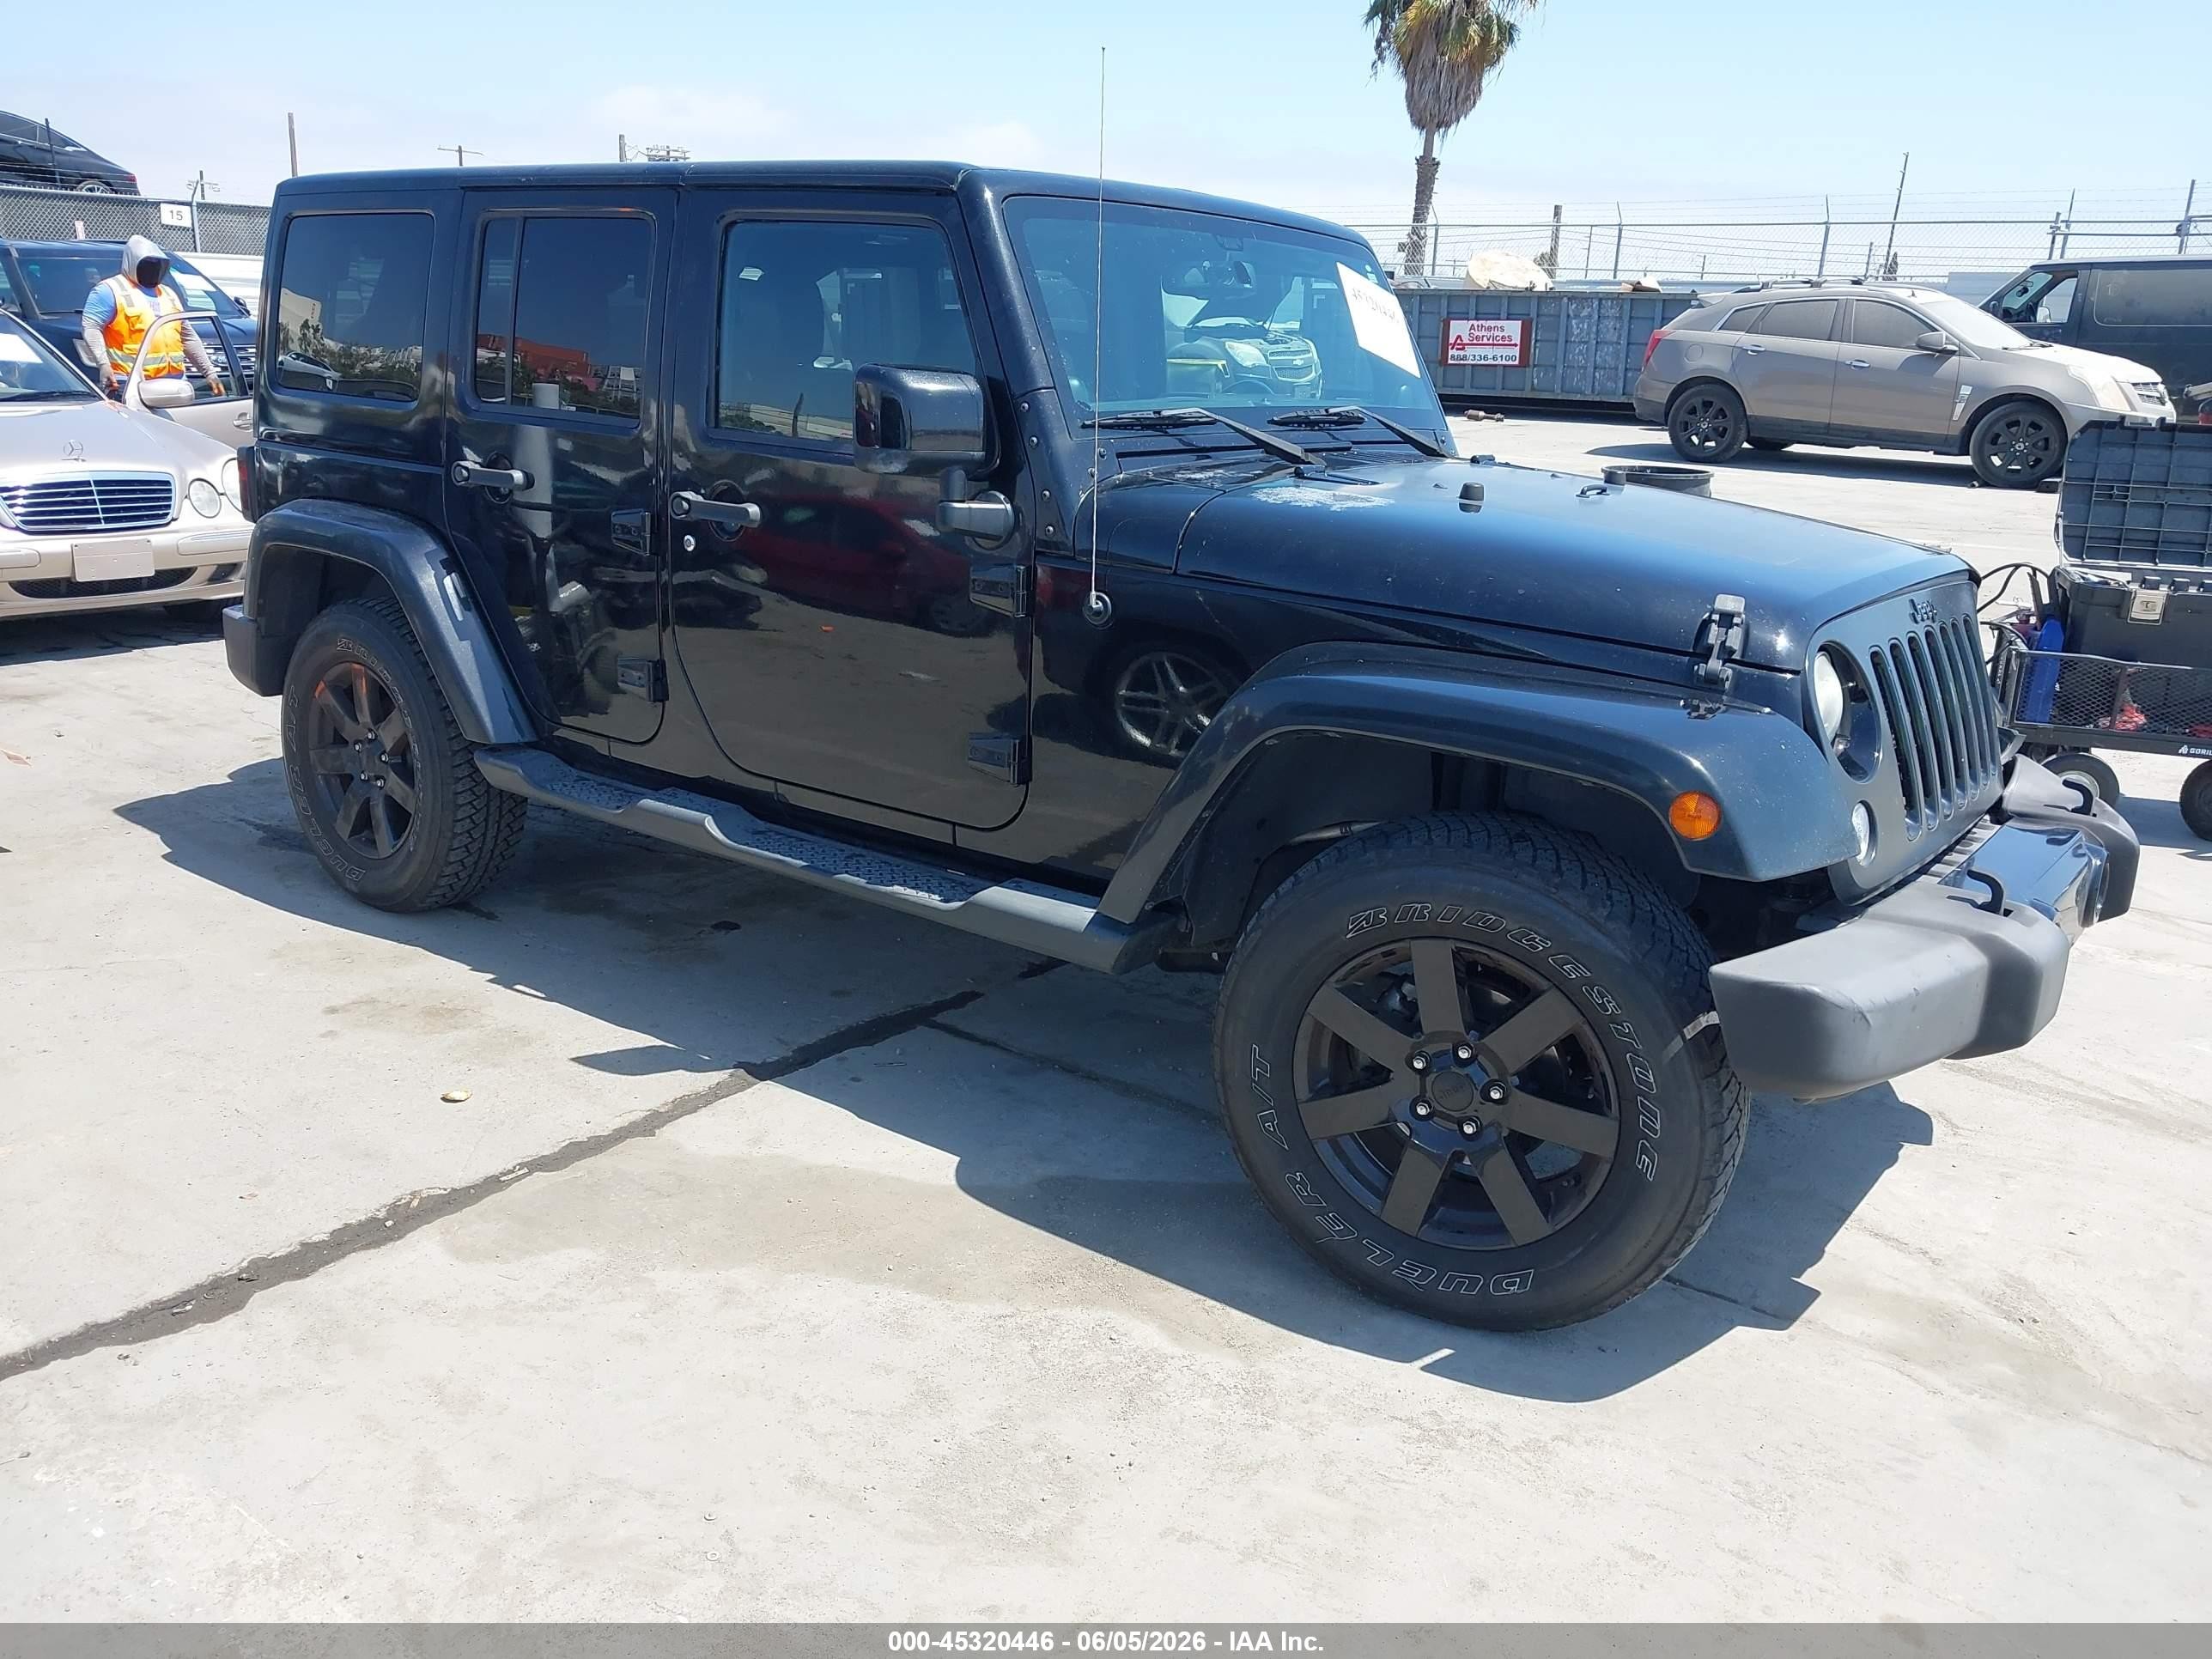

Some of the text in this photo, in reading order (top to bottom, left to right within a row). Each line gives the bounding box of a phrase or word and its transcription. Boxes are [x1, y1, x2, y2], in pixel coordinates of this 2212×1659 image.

[169, 209, 183, 221] 15
[1468, 323, 1505, 333] Athens
[1468, 331, 1513, 343] Services
[1449, 353, 1517, 362] 888/336-6100
[1909, 599, 1937, 625] Jeep
[289, 763, 366, 882] DUELER
[1345, 902, 1662, 1182] BRIDGESTONE
[1251, 1044, 1534, 1297] DUELER A/T
